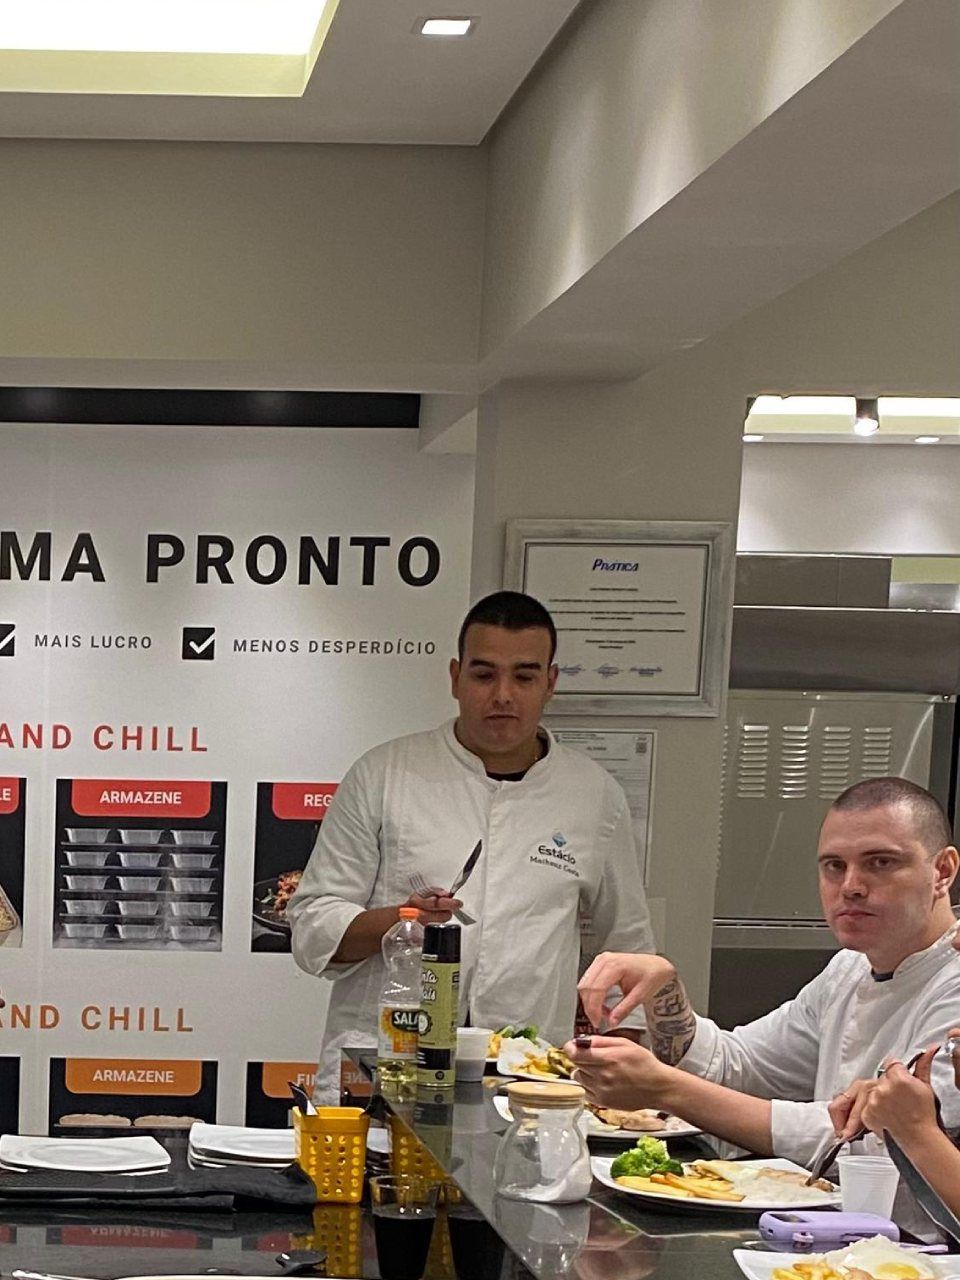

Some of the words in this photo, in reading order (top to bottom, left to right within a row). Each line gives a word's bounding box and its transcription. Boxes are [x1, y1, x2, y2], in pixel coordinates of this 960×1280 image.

[146, 534, 441, 587] PRONTO
[35, 634, 81, 648] MAIS
[90, 635, 152, 649] LUCRO
[233, 638, 299, 652] MENOS
[308, 638, 436, 655] DESPERDÍCIO
[93, 725, 208, 752] CHILL
[99, 790, 182, 805] ARMAZENE
[538, 844, 576, 865] Estácio
[81, 1005, 193, 1032] CHILL
[92, 1069, 175, 1083] ARMAZENE
